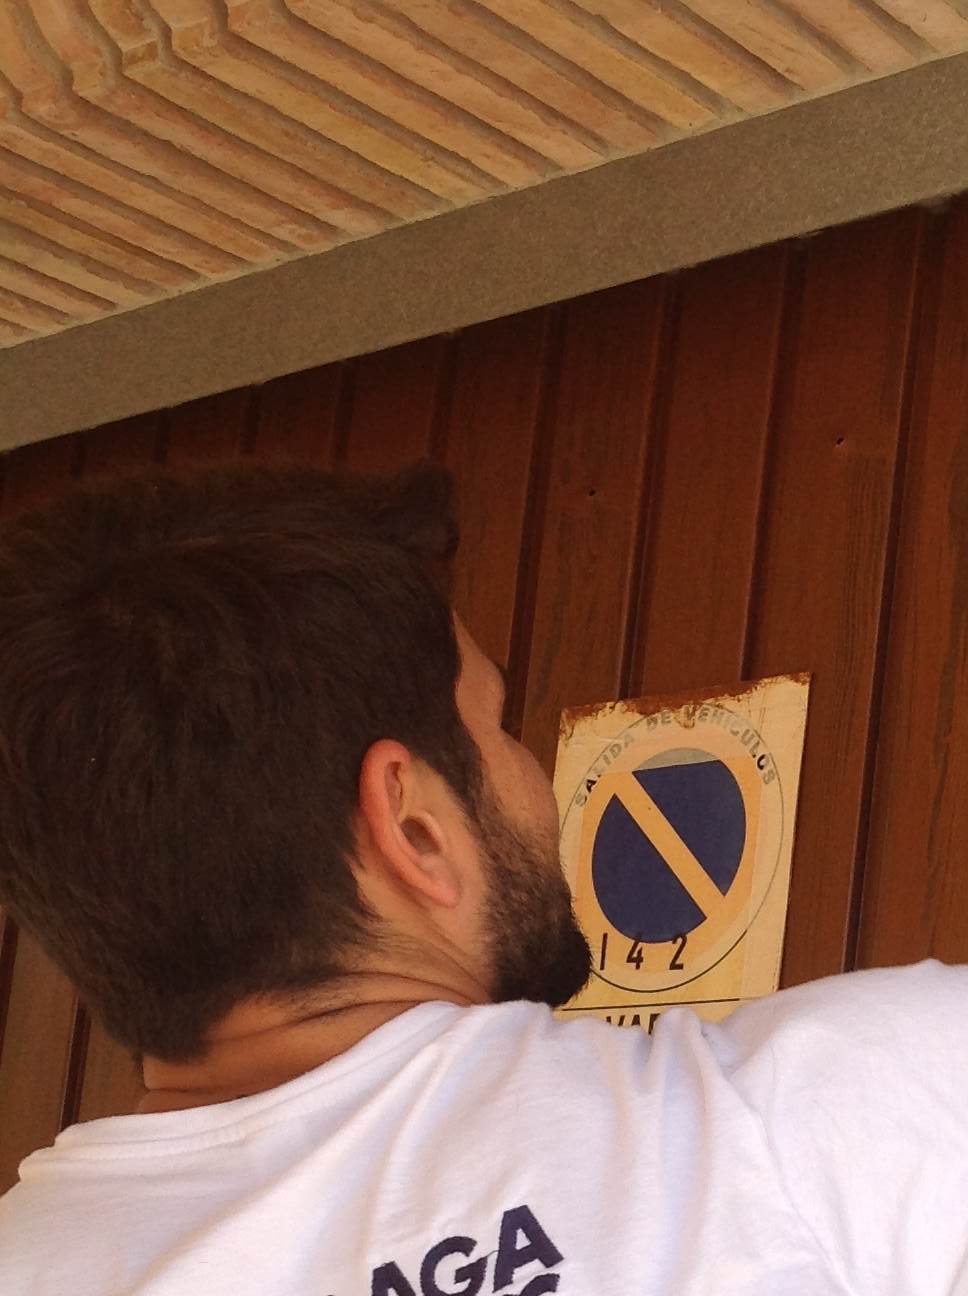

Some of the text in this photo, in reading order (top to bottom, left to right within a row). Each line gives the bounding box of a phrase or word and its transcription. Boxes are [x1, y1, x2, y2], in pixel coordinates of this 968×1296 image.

[575, 704, 776, 807] SALIDA DE VEHICULOS
